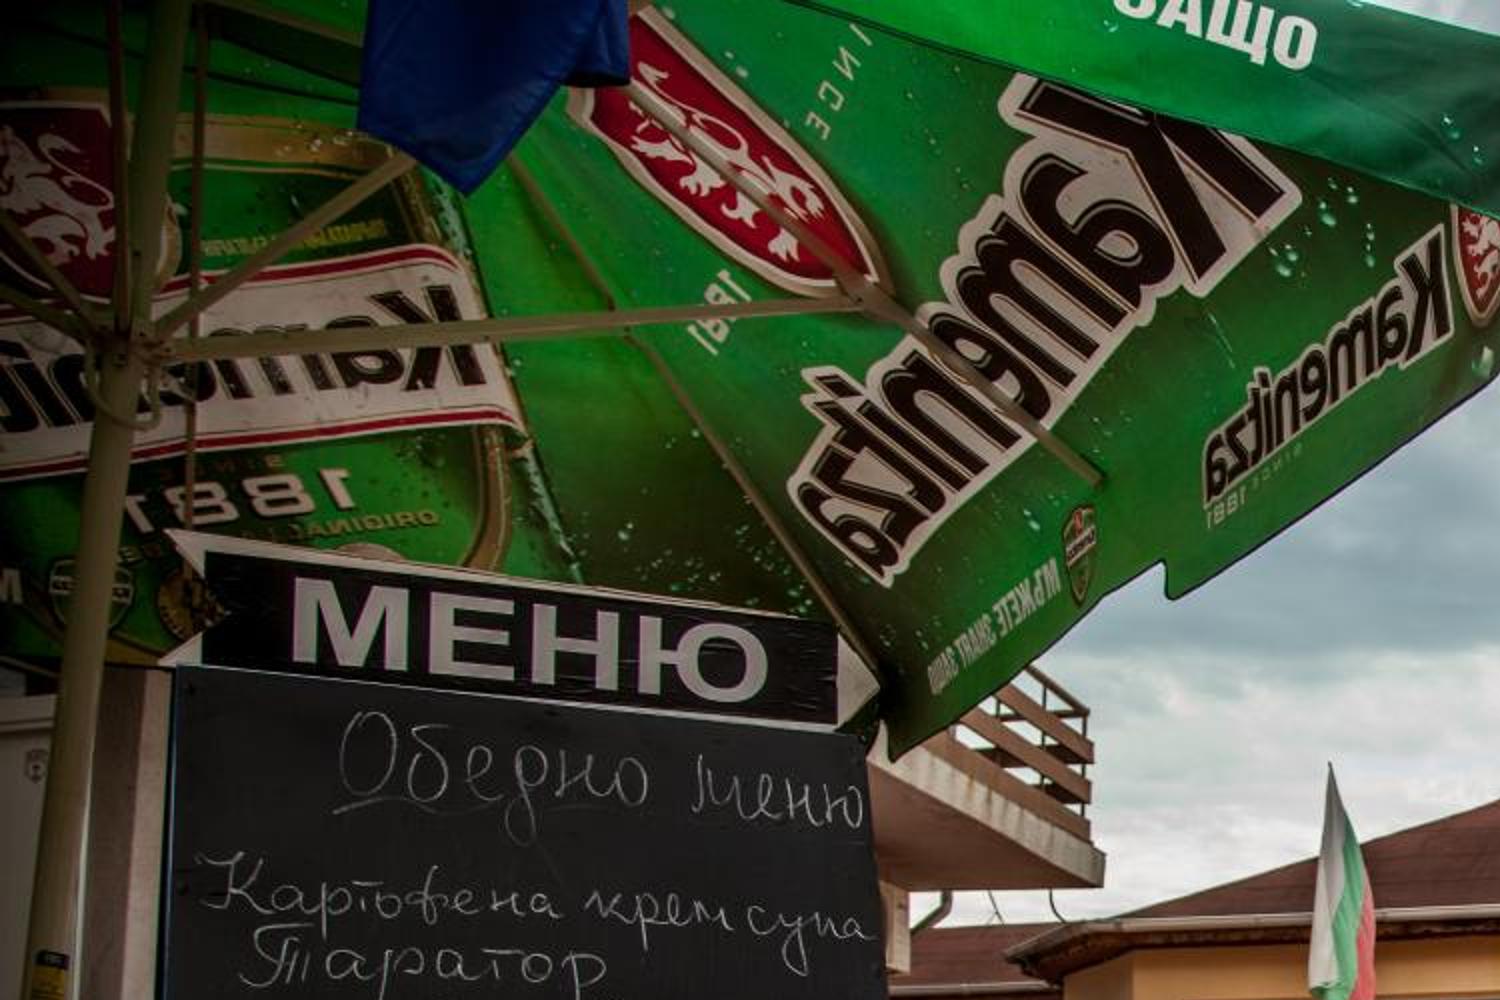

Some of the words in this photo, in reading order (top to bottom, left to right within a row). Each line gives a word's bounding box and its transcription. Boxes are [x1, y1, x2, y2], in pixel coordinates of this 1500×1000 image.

[292, 577, 769, 702] МЕНЮ
[691, 753, 864, 830] меню
[196, 849, 562, 938] Картофена
